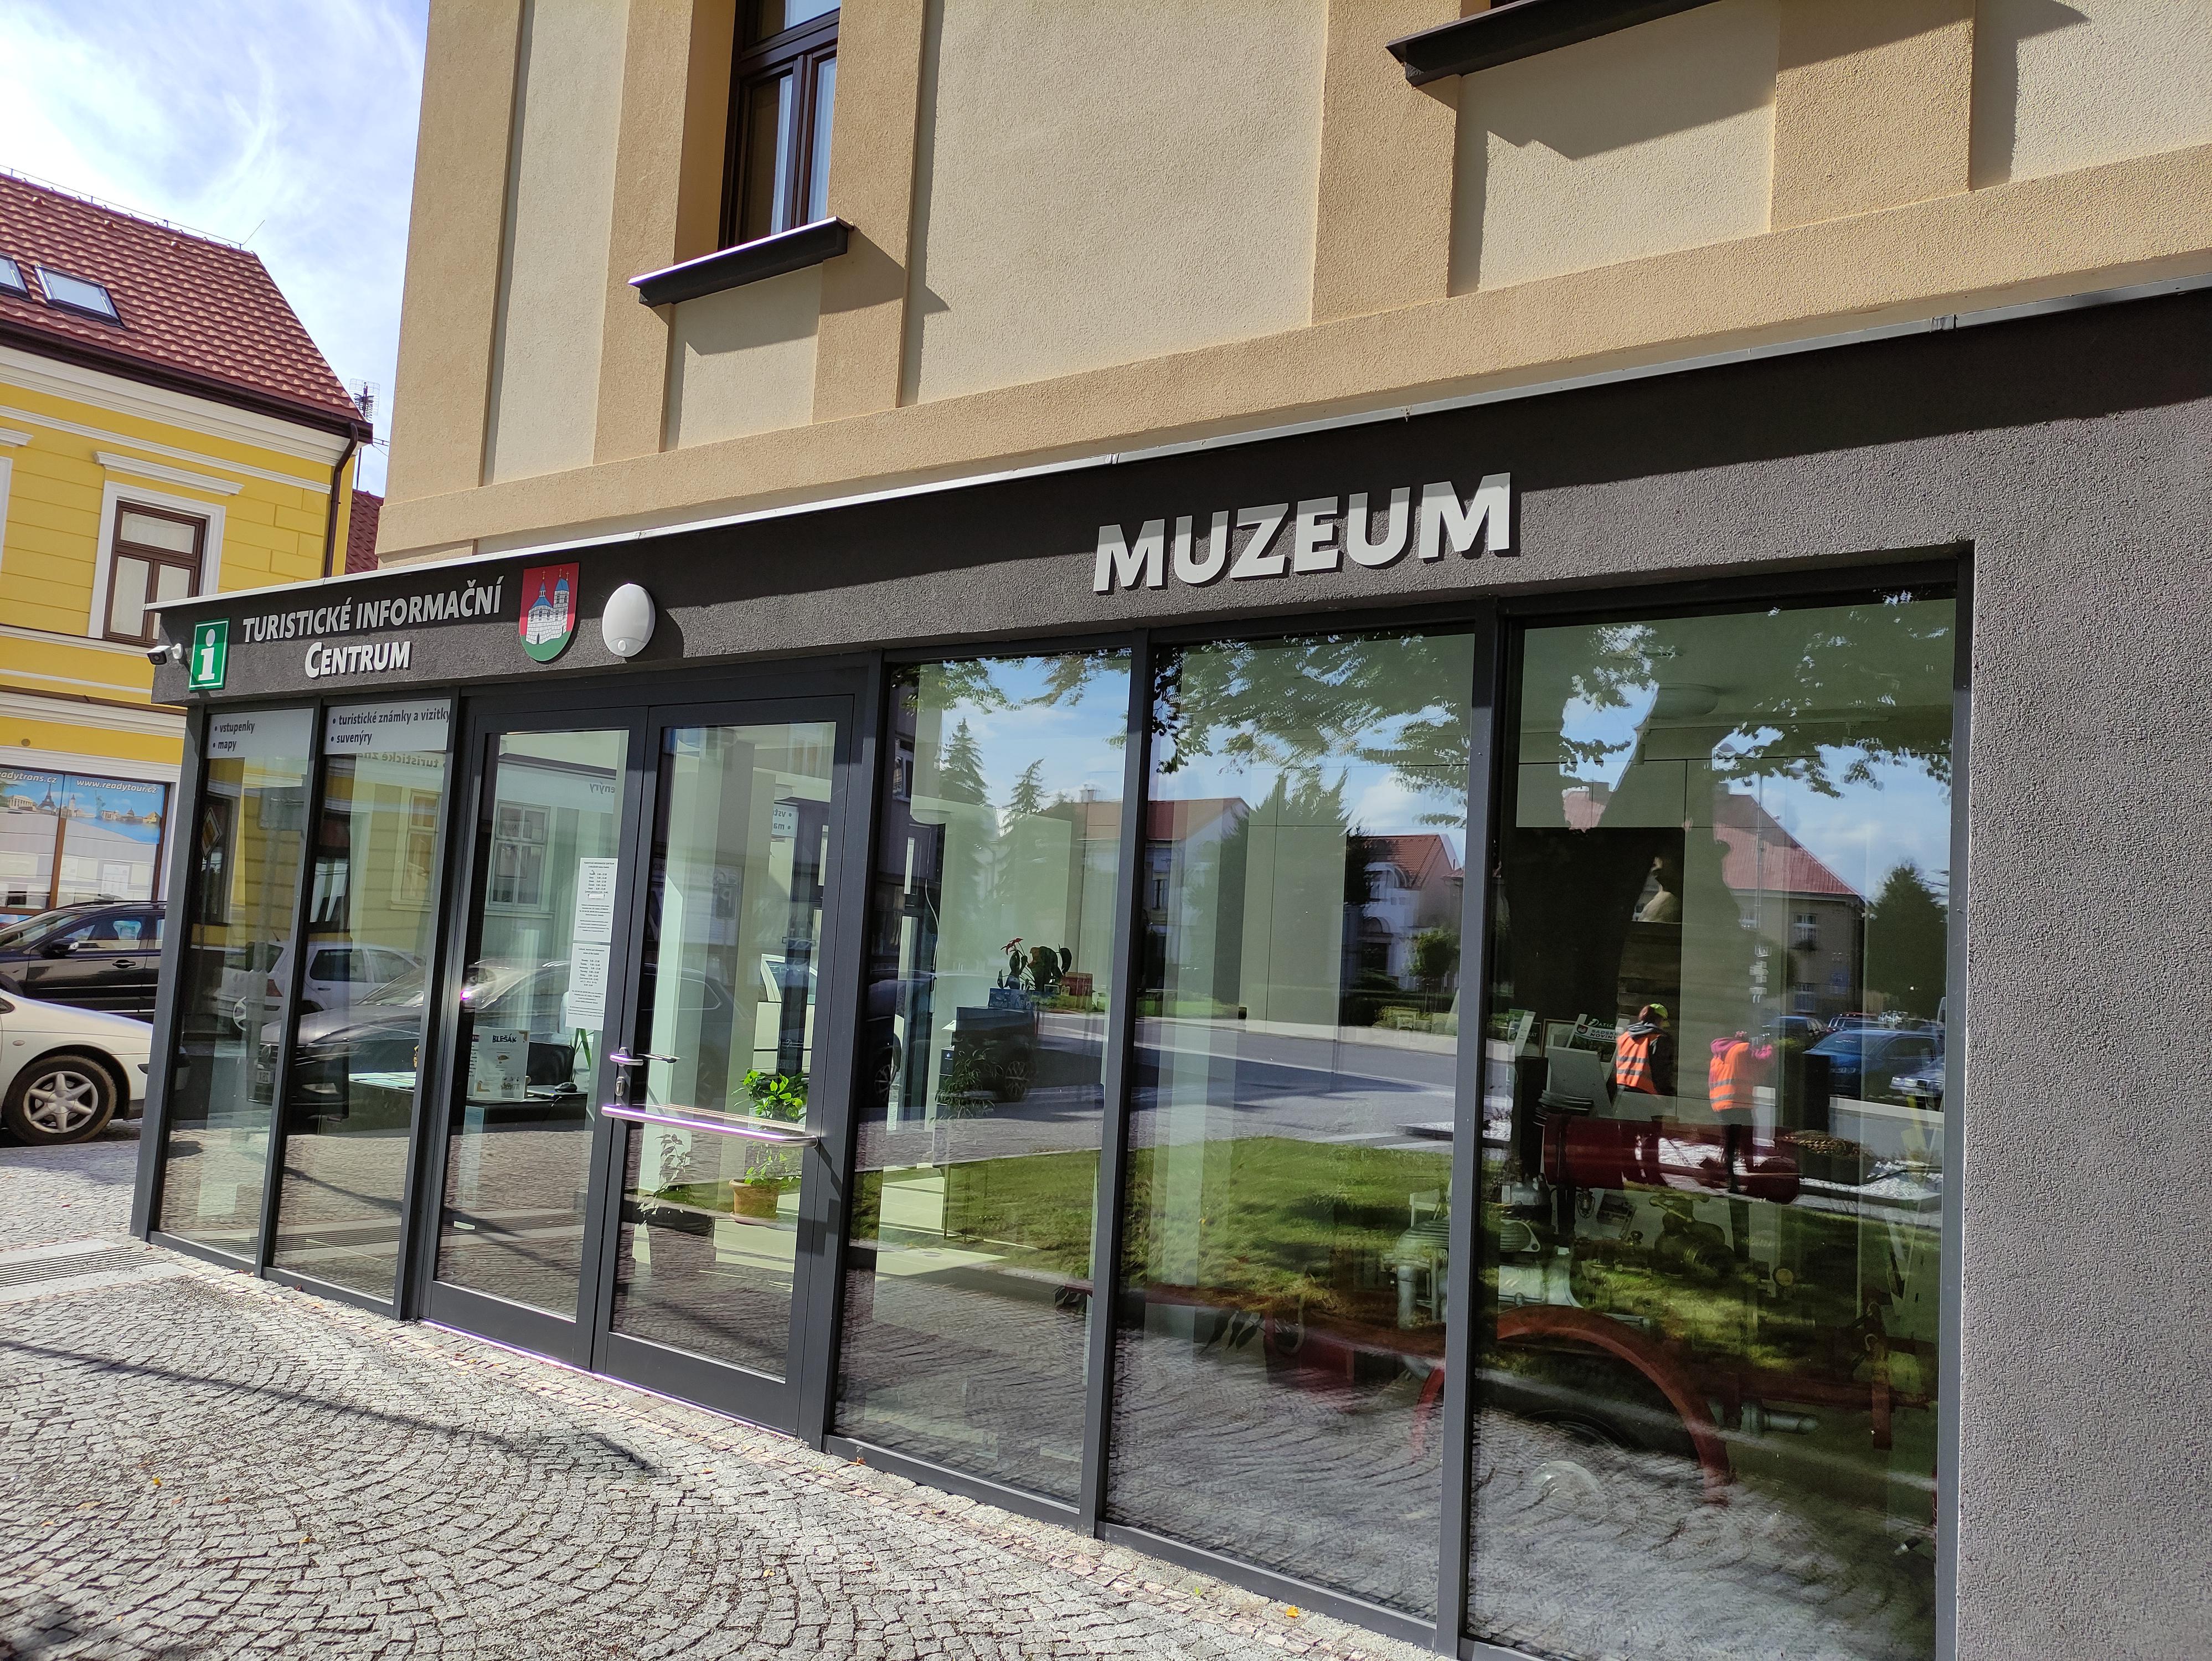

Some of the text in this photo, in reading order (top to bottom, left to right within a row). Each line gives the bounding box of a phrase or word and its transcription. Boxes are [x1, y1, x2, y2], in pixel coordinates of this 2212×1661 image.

[1094, 472, 1510, 592] MUZEUM
[243, 576, 504, 643] TURISTICKÉ INFORMAČNÍ
[305, 641, 411, 679] CENTRUM
[338, 707, 450, 725] turistické známky a vizitky
[219, 720, 255, 735] vstupenky
[336, 730, 373, 746] suvenýry
[218, 741, 237, 752] mapy
[0, 771, 58, 783] adytrans.cz
[76, 778, 158, 794] www.readytour.cz
[492, 1033, 517, 1043] BLEŠÁK
